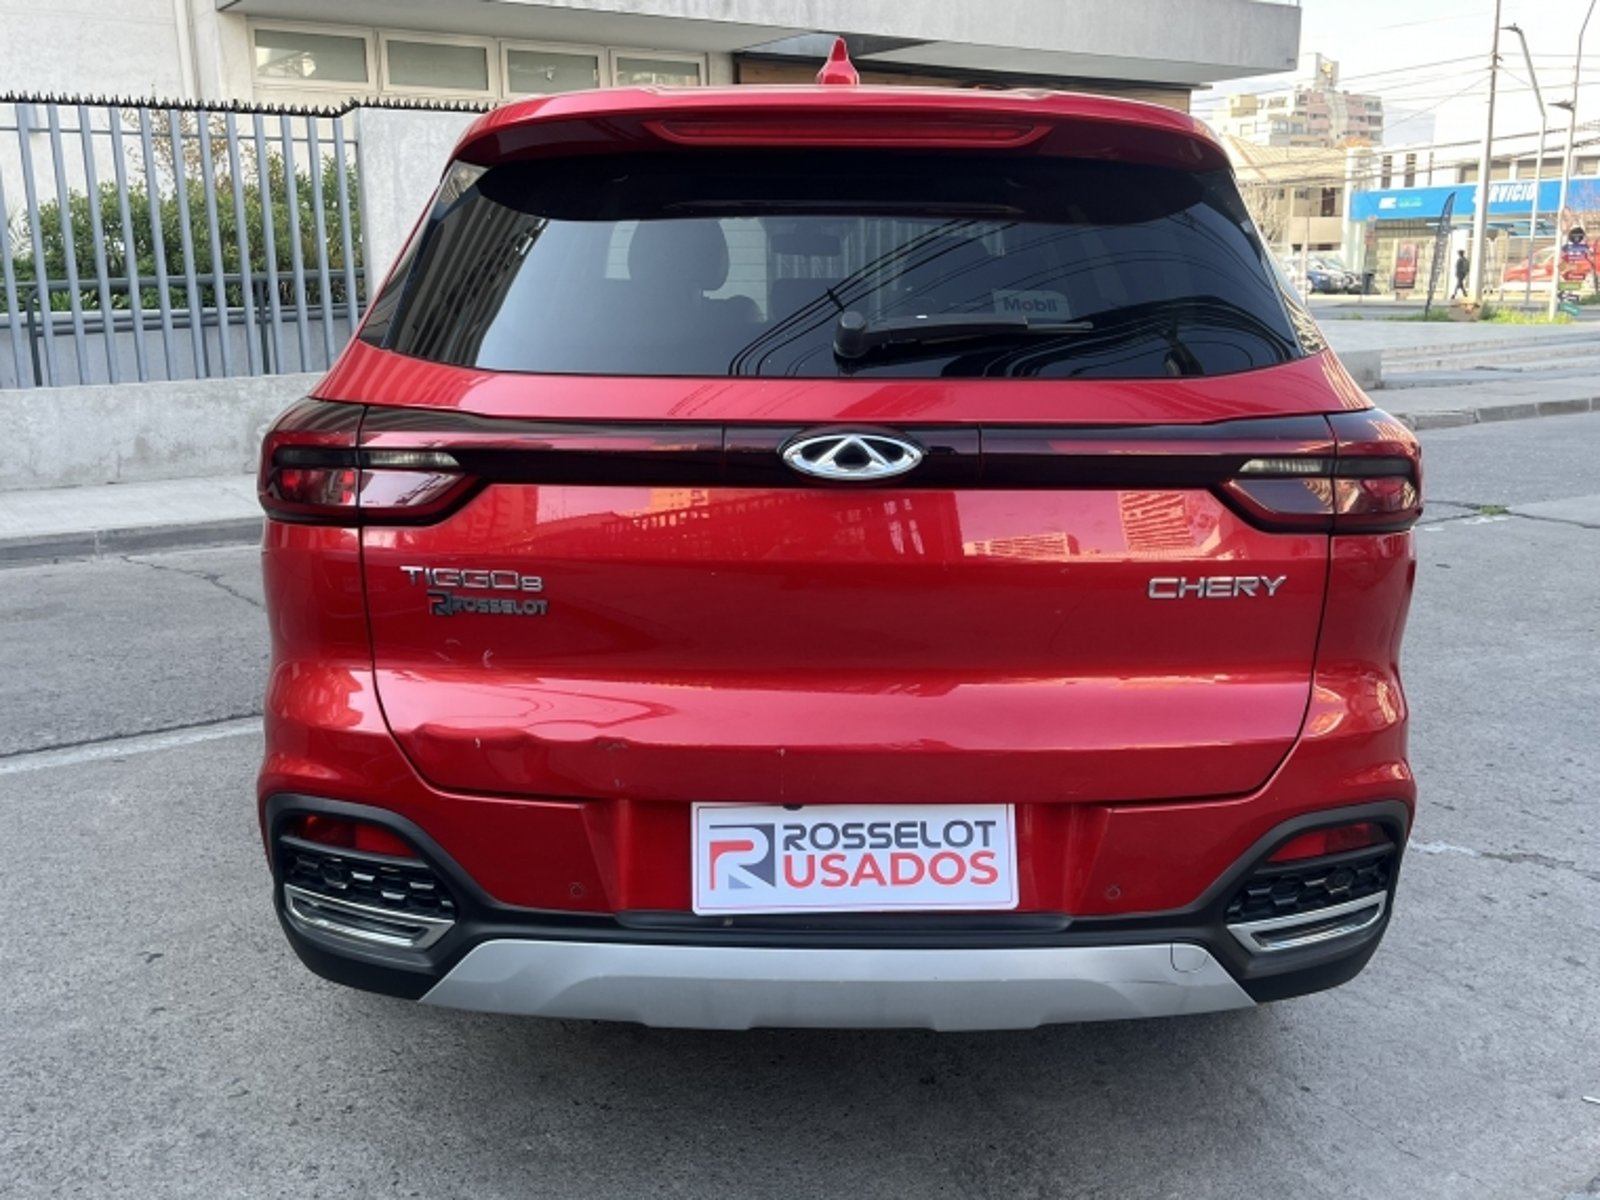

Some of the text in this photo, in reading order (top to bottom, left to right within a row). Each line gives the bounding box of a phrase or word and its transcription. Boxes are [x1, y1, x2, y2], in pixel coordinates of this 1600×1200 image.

[1472, 184, 1535, 204] RVICIO
[1149, 574, 1287, 599] CHERY
[782, 819, 997, 851] ROSSELOT
[783, 850, 999, 889] USADOS
